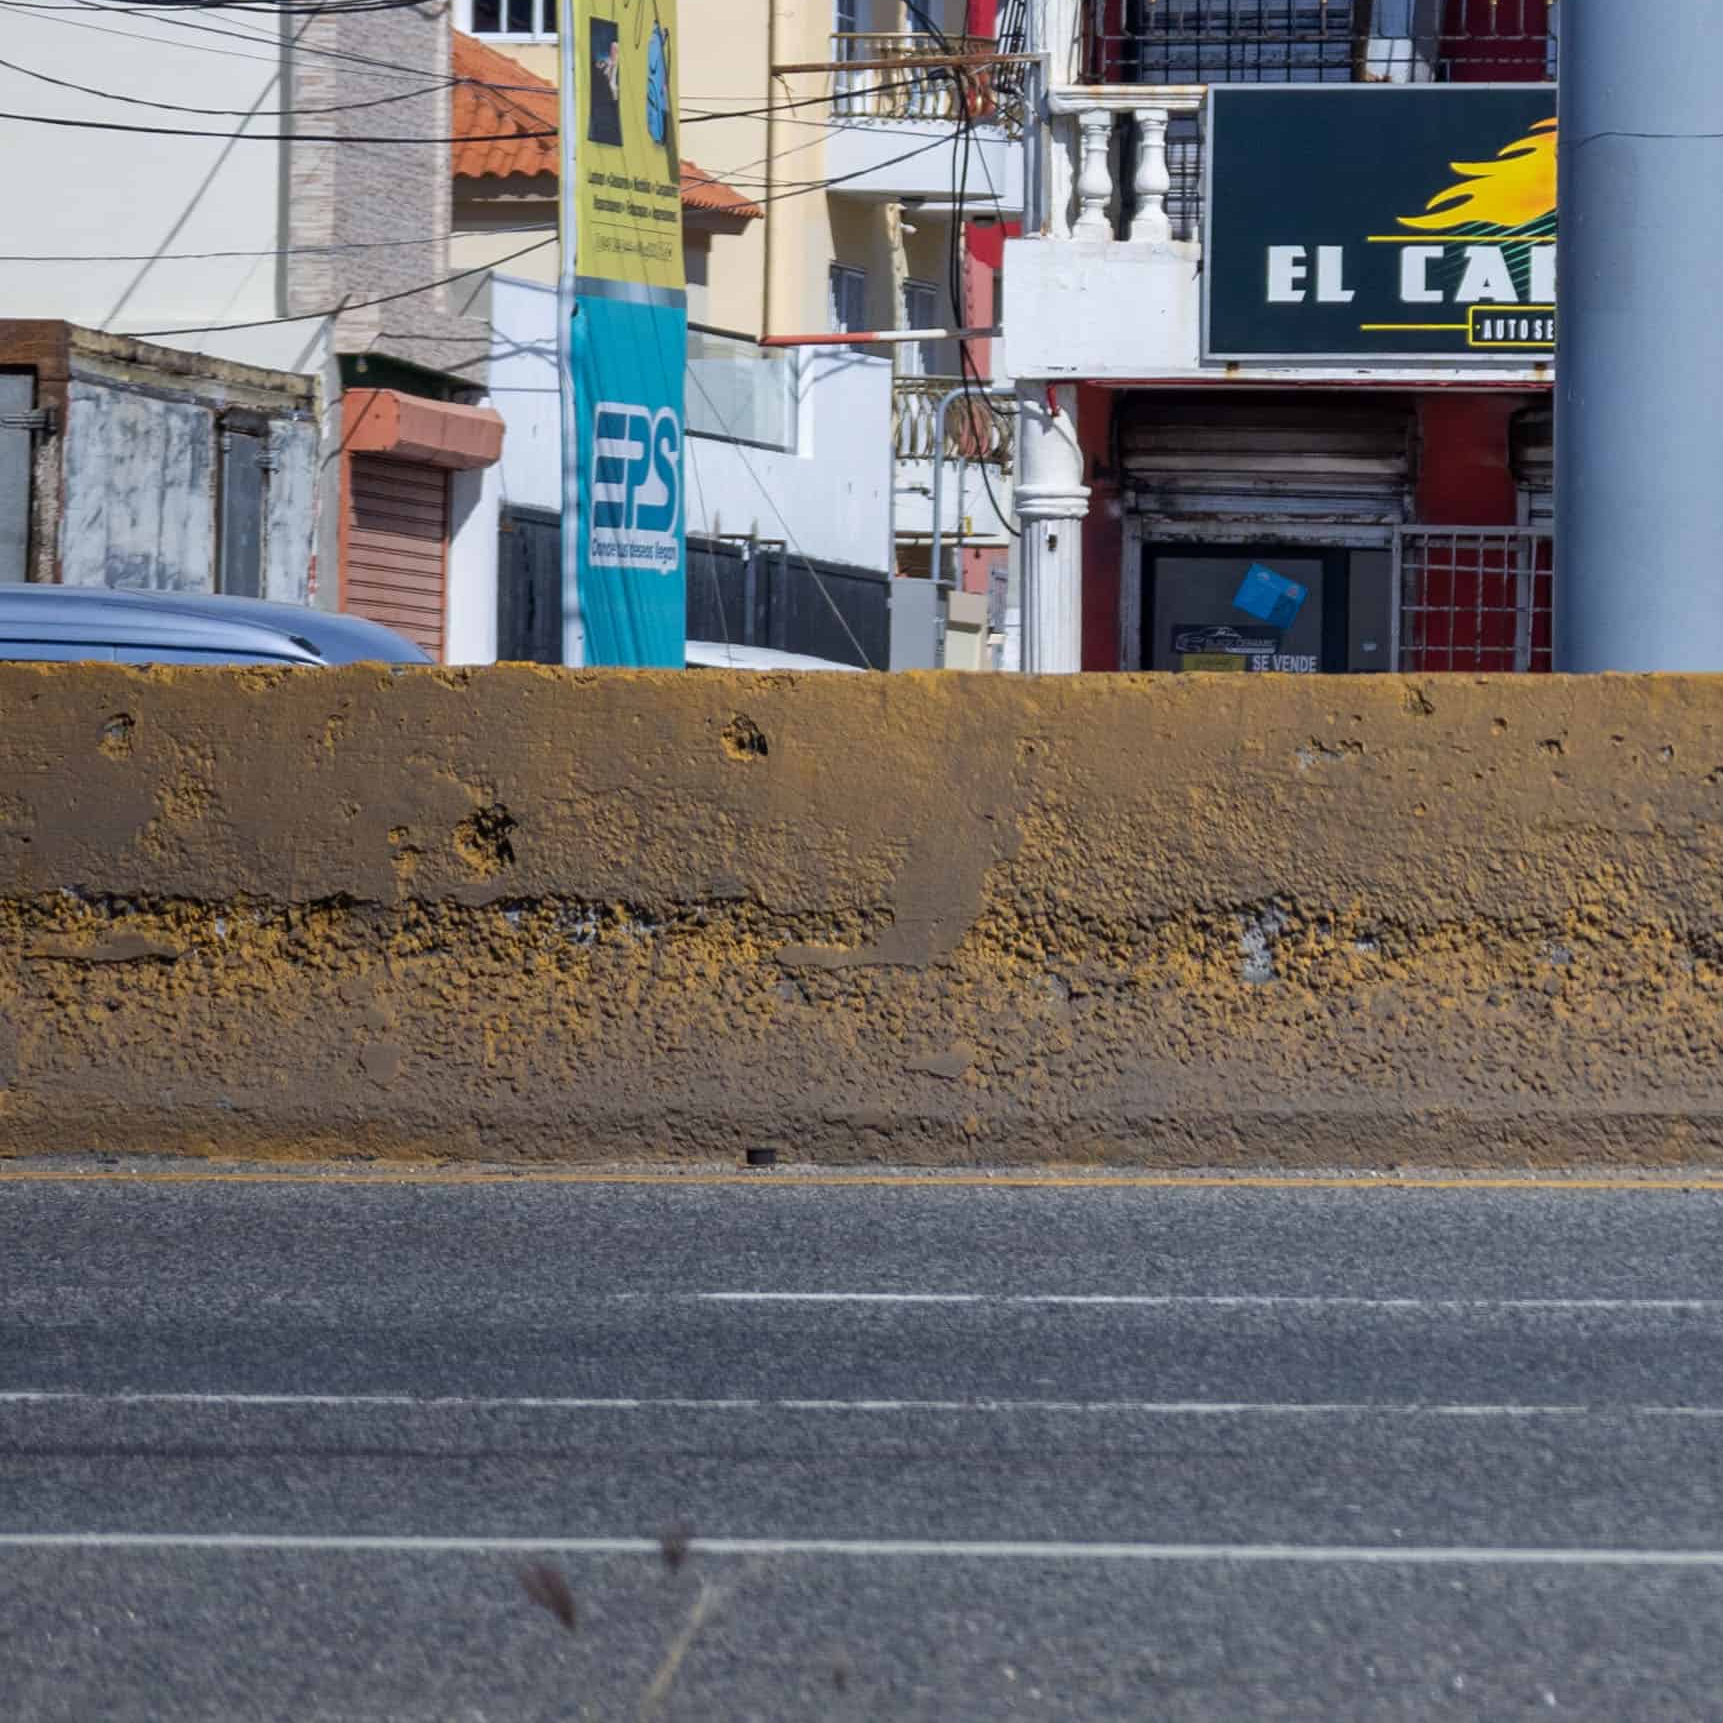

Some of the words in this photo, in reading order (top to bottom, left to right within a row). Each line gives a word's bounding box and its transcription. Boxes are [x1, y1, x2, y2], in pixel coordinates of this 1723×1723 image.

[1267, 245, 1355, 302] EL
[1483, 319, 1528, 339] AUTO
[593, 410, 678, 533] EPS
[1252, 655, 1270, 671] SE
[1273, 655, 1317, 672] VENDE
